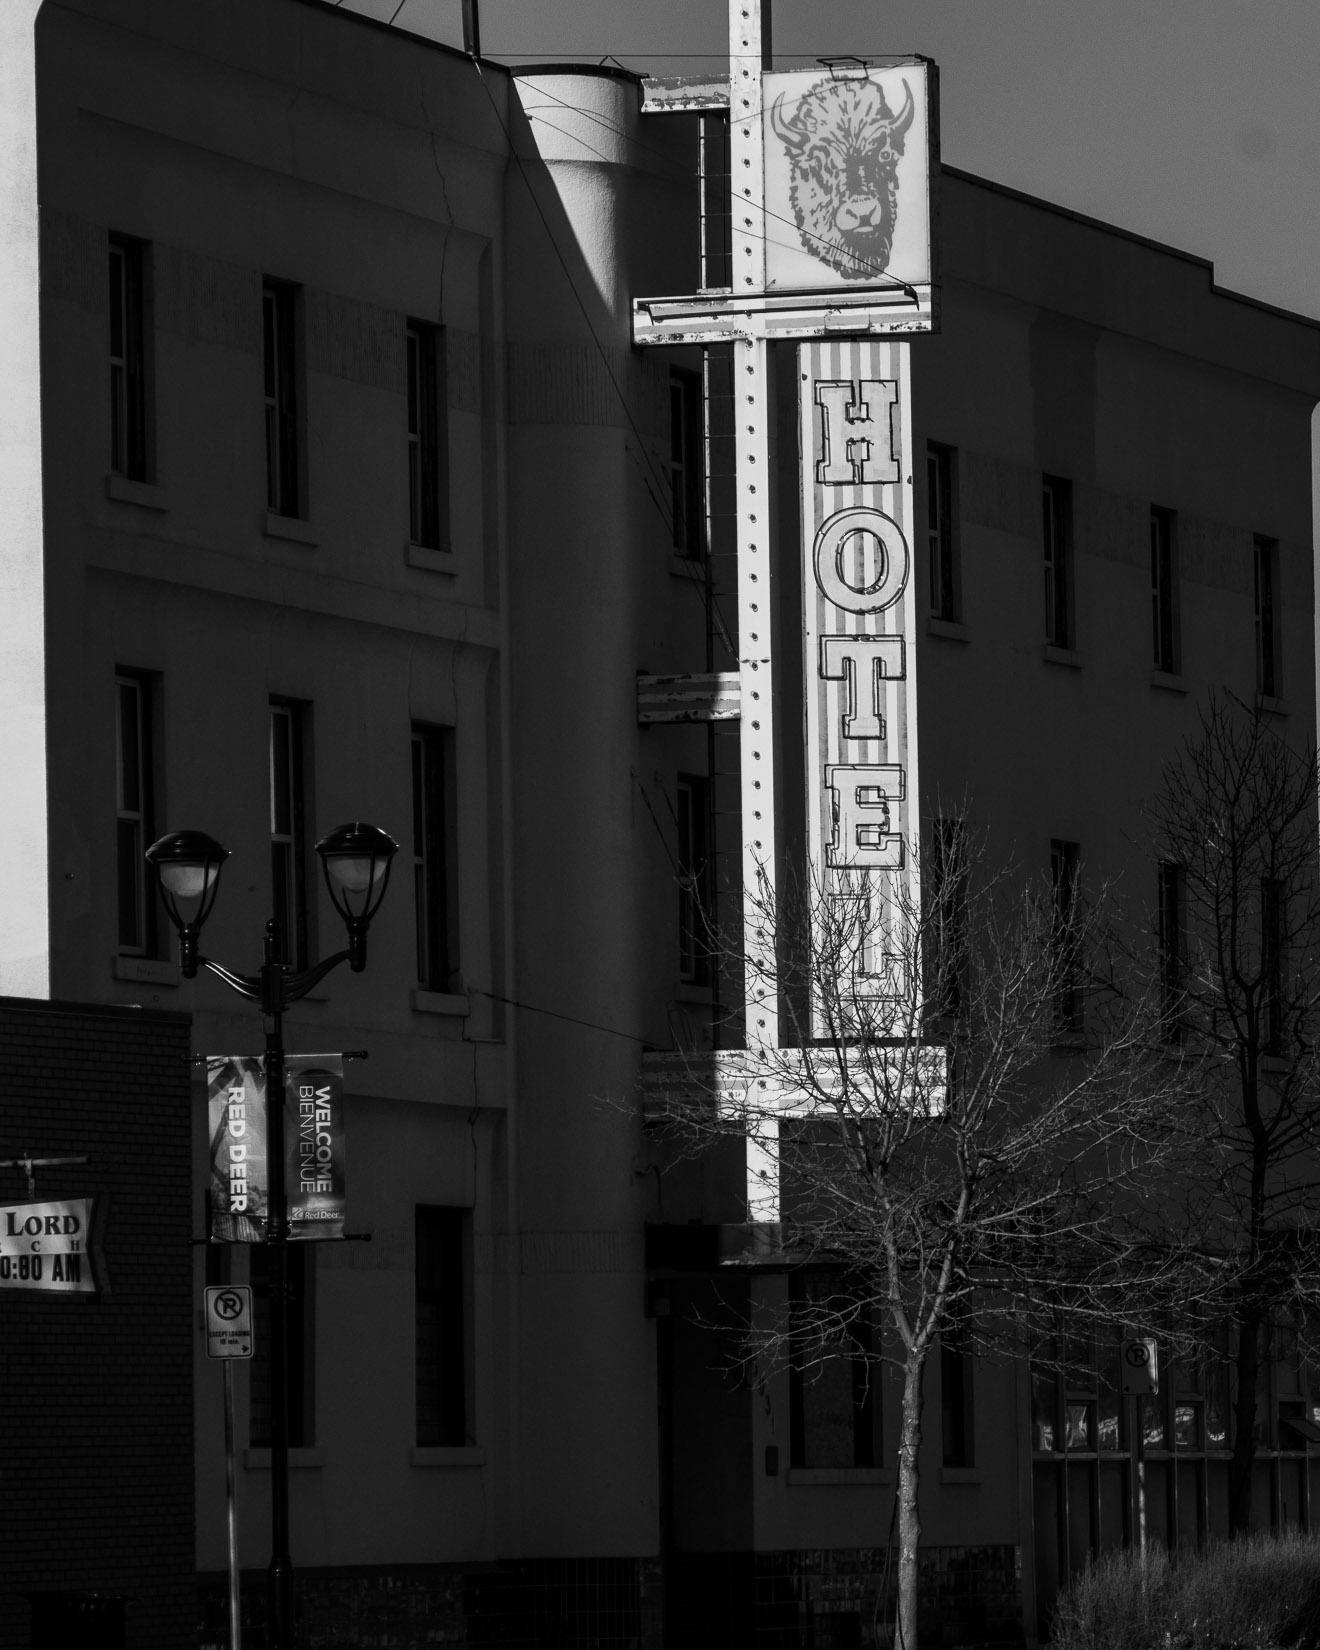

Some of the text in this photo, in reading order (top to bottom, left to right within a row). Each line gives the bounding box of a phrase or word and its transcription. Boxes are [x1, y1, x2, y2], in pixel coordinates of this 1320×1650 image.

[812, 379, 910, 1002] HOTEL
[228, 1086, 247, 1212] RED DEER
[299, 1085, 316, 1193] BIENVENUE
[315, 1085, 333, 1193] WELCOME
[6, 1211, 80, 1236] LORD
[52, 1253, 81, 1282] AM
